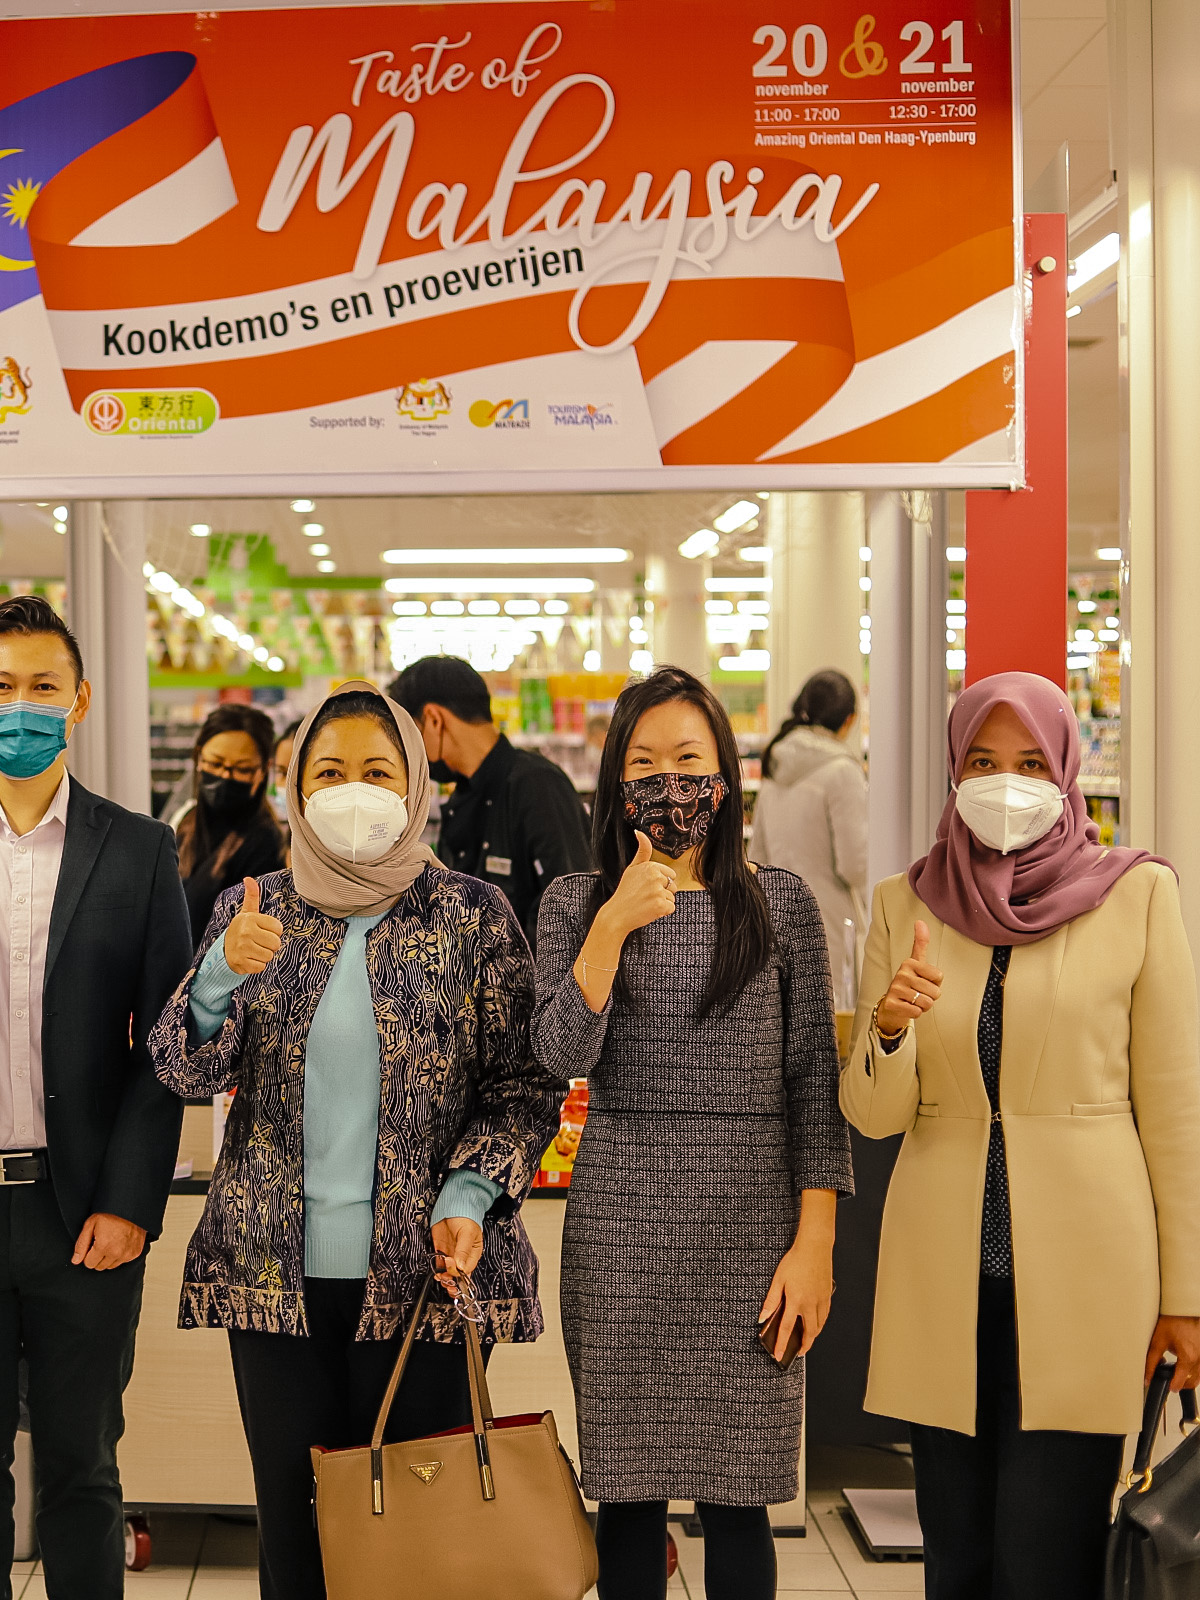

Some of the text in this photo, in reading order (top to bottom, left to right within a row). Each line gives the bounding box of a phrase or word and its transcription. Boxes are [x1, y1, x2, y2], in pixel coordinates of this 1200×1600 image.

[752, 14, 973, 79] 20 & 21
[349, 22, 563, 107] Taste of
[755, 81, 829, 97] november
[901, 78, 975, 93] november
[754, 108, 792, 122] 11:00
[804, 107, 840, 121] 17:00
[889, 105, 928, 118] 12:30
[940, 104, 977, 117] 17:00
[755, 130, 976, 148] Amazing Oriental Den Haag-Ypenburg
[256, 73, 880, 354] Malaysia
[103, 246, 584, 356] Kookdemo’s en proeverijen
[139, 395, 195, 411] 東方行
[548, 404, 587, 414] TOURISM
[128, 416, 203, 432] Oriental
[309, 416, 385, 429] Supported by:
[554, 414, 613, 430] MALAYSIA
